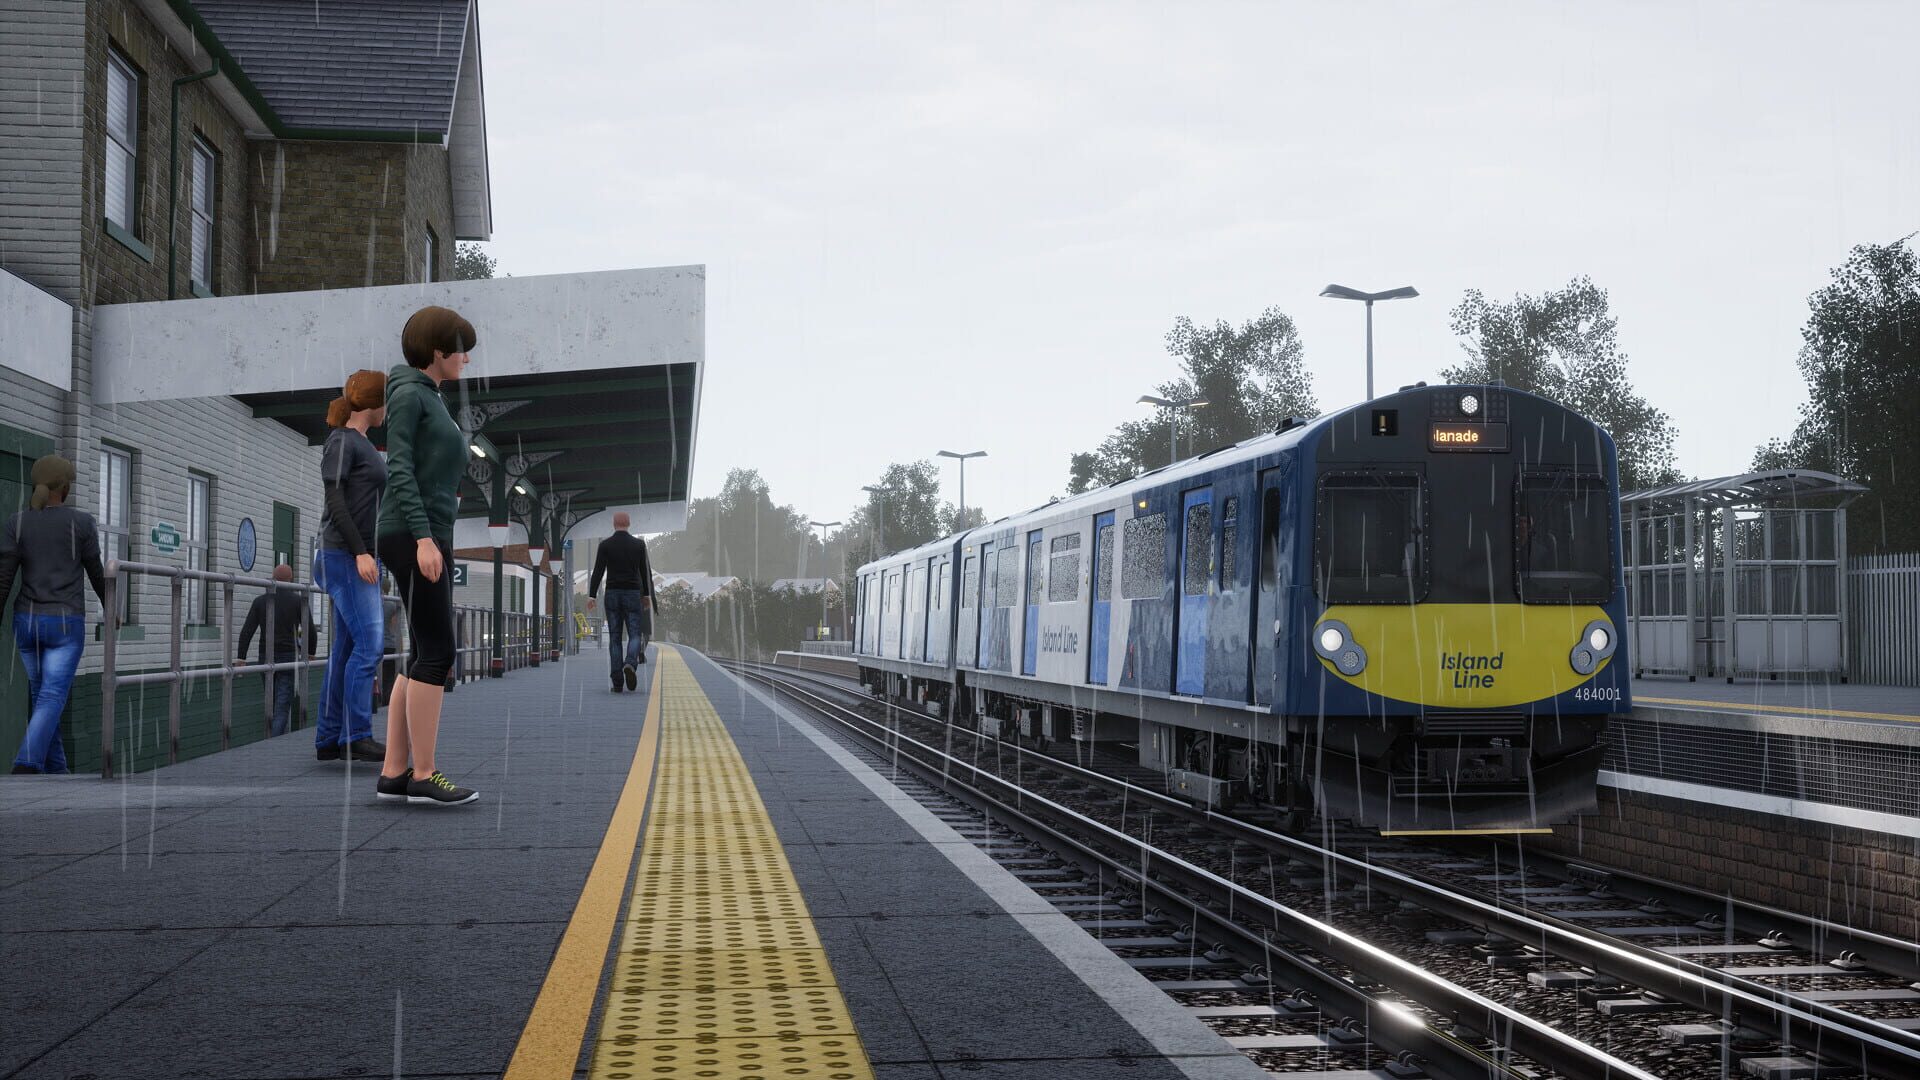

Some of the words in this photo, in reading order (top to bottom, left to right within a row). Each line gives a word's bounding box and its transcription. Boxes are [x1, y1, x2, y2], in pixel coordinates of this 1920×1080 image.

[1433, 429, 1479, 442] lanade
[453, 567, 462, 583] 2
[1042, 625, 1063, 653] Island
[1063, 625, 1078, 655] Line
[1441, 651, 1504, 670] Island
[1454, 670, 1495, 689] Line
[1575, 687, 1622, 701] 484001
